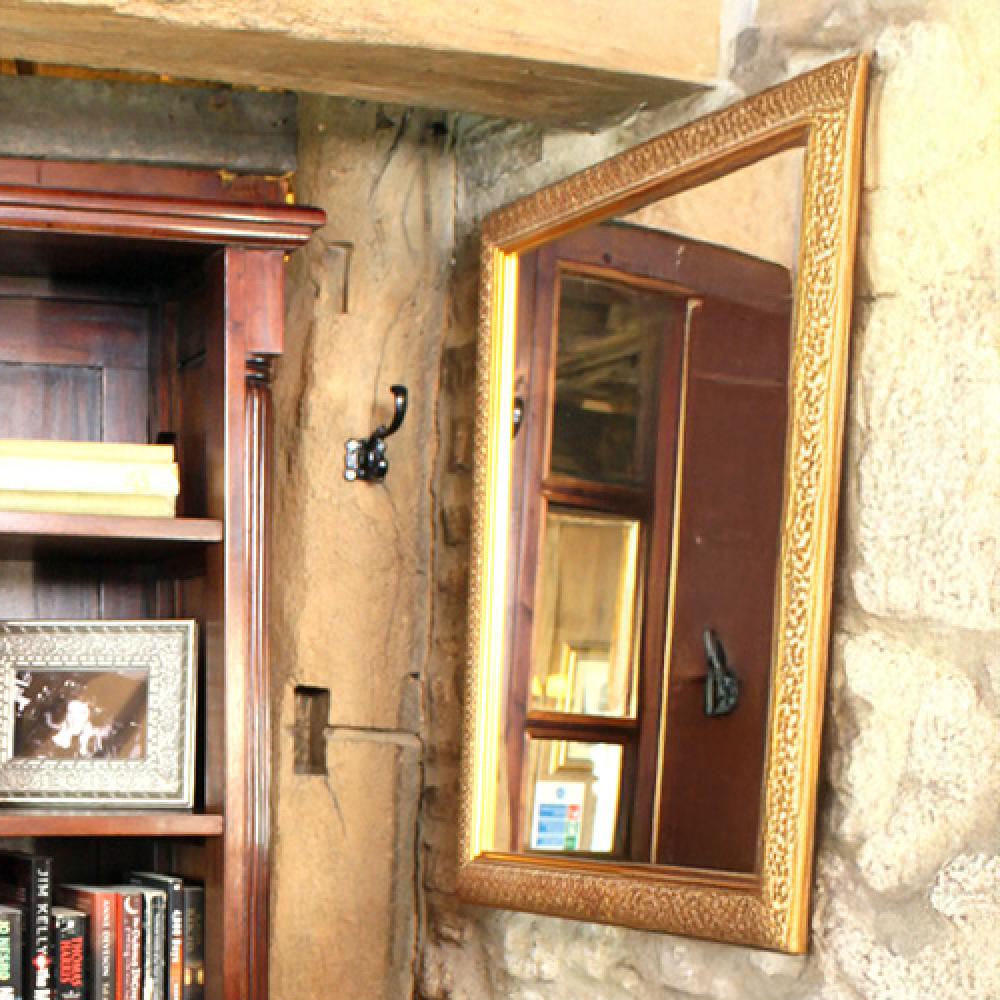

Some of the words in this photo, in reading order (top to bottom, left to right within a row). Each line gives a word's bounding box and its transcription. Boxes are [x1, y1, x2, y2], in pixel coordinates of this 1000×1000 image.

[37, 868, 49, 897] JIM
[36, 903, 49, 954] KELLY
[60, 940, 72, 984] HARRIS
[72, 937, 85, 986] THOMAS
